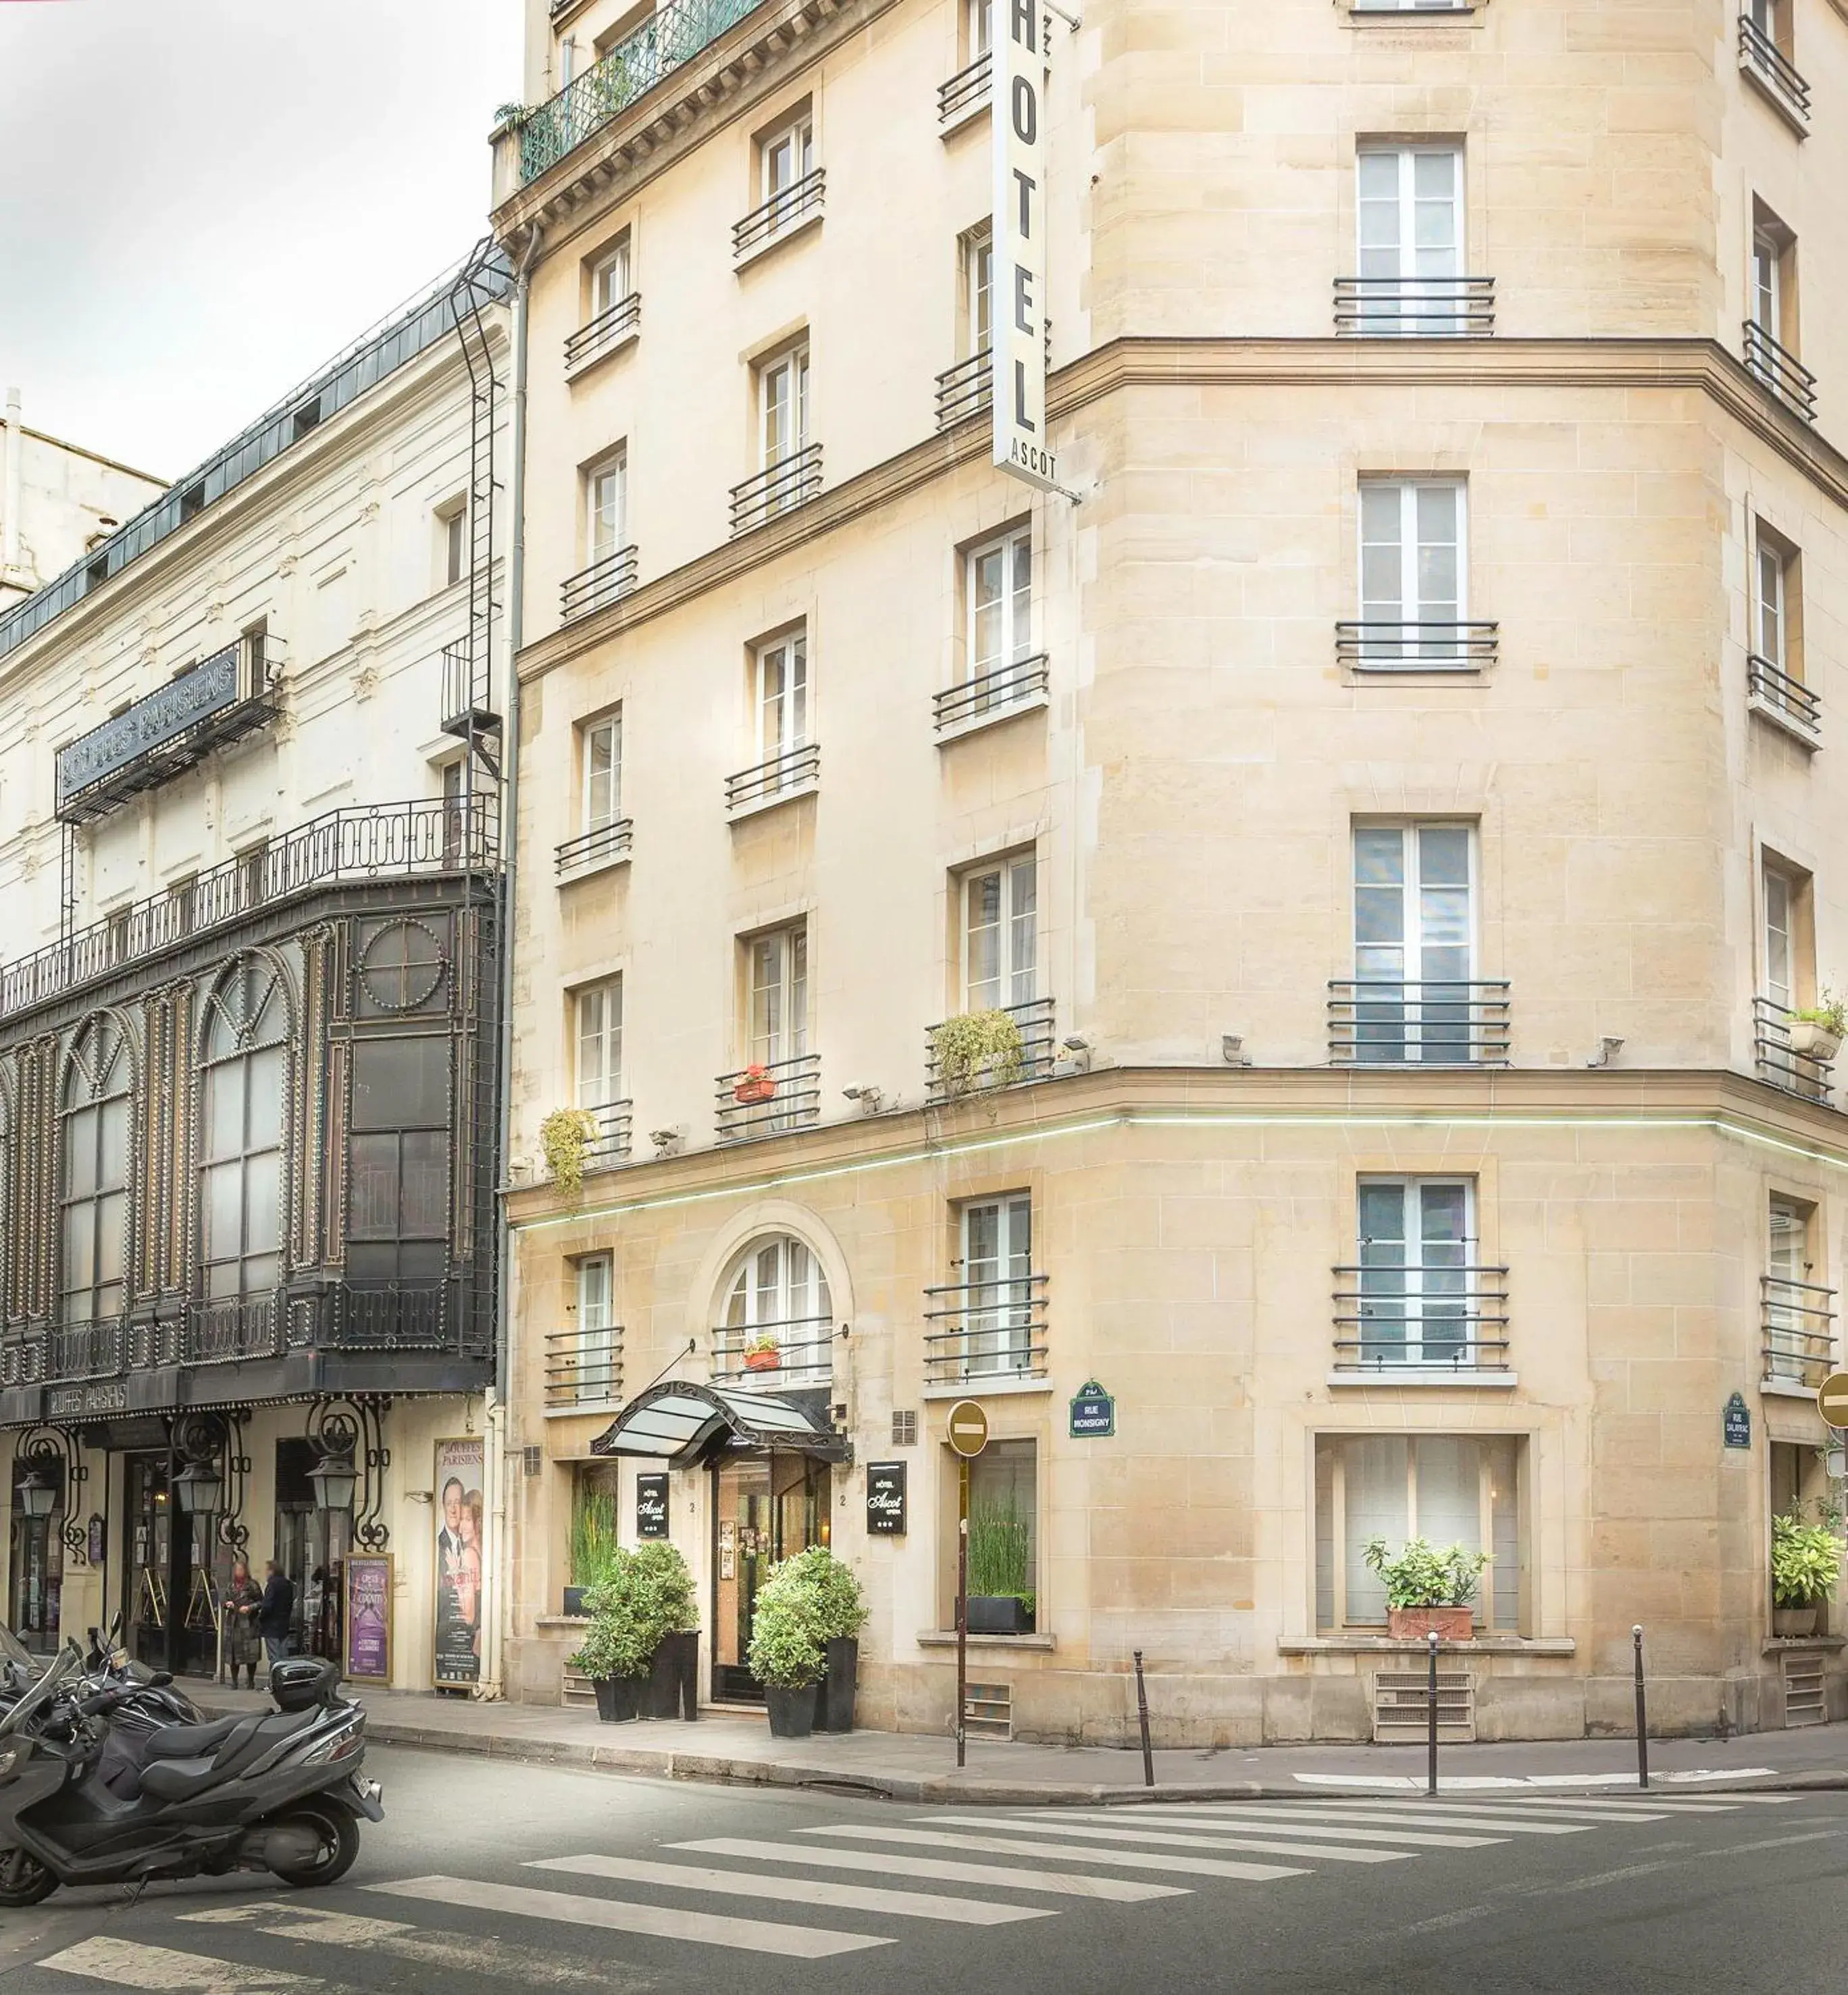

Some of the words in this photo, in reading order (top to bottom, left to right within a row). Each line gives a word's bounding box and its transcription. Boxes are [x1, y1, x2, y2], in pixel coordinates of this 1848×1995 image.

[1011, 0, 1036, 433] HOTEL
[1012, 437, 1056, 479] ASCOT
[139, 659, 235, 742] PARISIENS
[1084, 1405, 1099, 1415] RUE
[1073, 1418, 1110, 1428] MONSIGNY
[637, 1500, 665, 1515] Ascot
[690, 1502, 695, 1513] 2
[840, 1494, 846, 1507] 2
[867, 1491, 902, 1509] Ascot
